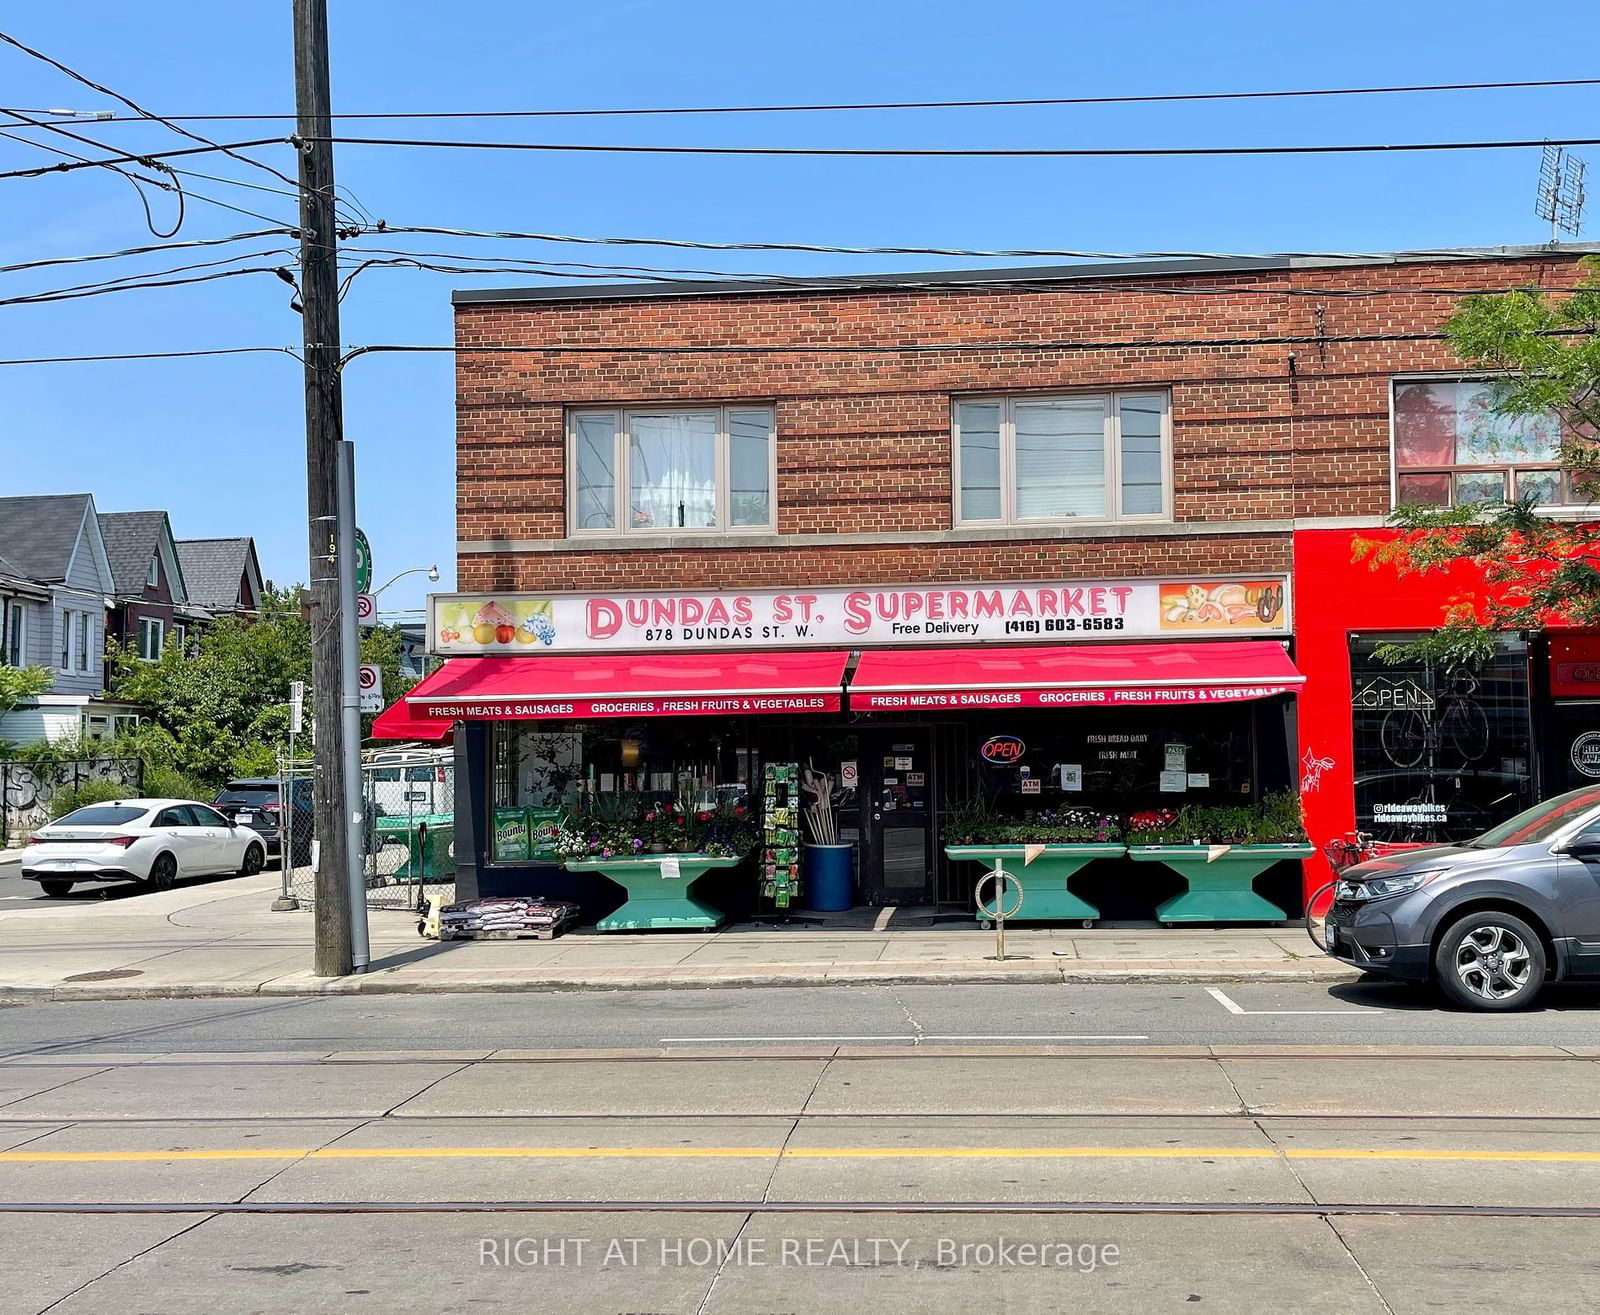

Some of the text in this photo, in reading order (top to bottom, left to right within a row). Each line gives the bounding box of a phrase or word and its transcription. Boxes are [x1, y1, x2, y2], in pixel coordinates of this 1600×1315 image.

[327, 534, 336, 564] 194
[585, 586, 1134, 640] DUNDAS ST. SUPERMARKET
[892, 621, 979, 636] Free Delivery
[1044, 618, 1124, 631] 603-6583
[645, 625, 814, 641] 878 DUNDAS ST. W.
[871, 694, 1021, 706] FRESH MEATS & SAUSAGES
[1039, 692, 1105, 703] GROCERIES
[1114, 691, 1152, 701] FRESH
[1155, 690, 1195, 700] FRUITS
[1199, 690, 1207, 699] &
[1362, 688, 1418, 707] OPEN
[428, 704, 573, 716] FRESH MEATS & SAUSAGES
[591, 702, 654, 713] GROCERIES
[662, 701, 698, 711] FRESH
[701, 700, 740, 710] FRUITS
[743, 700, 750, 709] &
[753, 698, 824, 709] VEGETABLES
[1087, 734, 1106, 743] FRESH
[1108, 734, 1129, 743] BREAD
[984, 742, 1022, 757] OPEN
[1099, 750, 1138, 759] FRESH MEAT
[496, 823, 526, 841] Bounty
